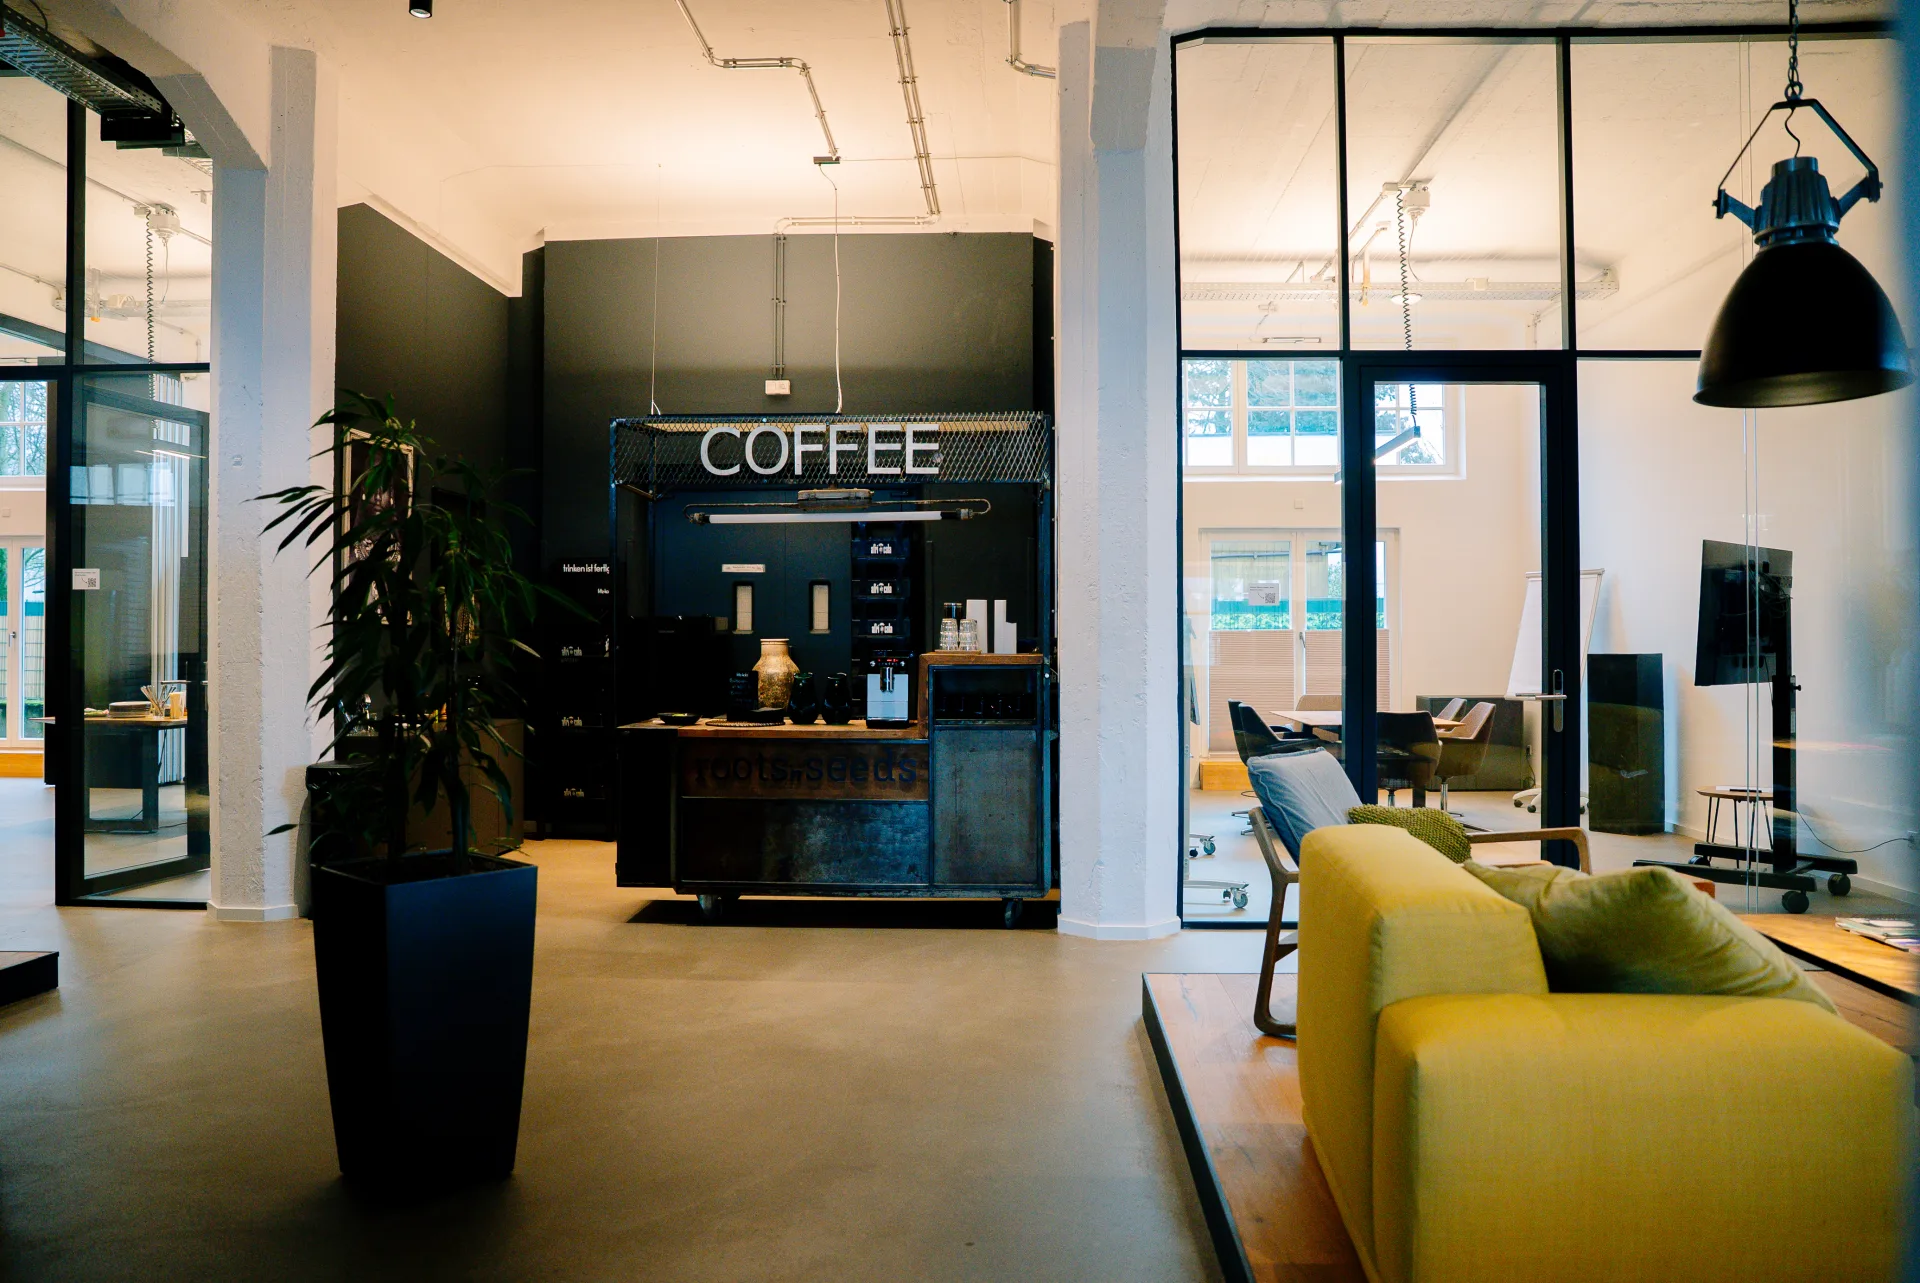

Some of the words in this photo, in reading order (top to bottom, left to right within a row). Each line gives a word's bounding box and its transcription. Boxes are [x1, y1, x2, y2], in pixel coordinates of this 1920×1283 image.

[700, 424, 940, 476] COFFEE
[563, 563, 585, 573] trinken
[585, 563, 593, 573] ist
[695, 753, 788, 783] roots
[805, 748, 918, 783] seeds
